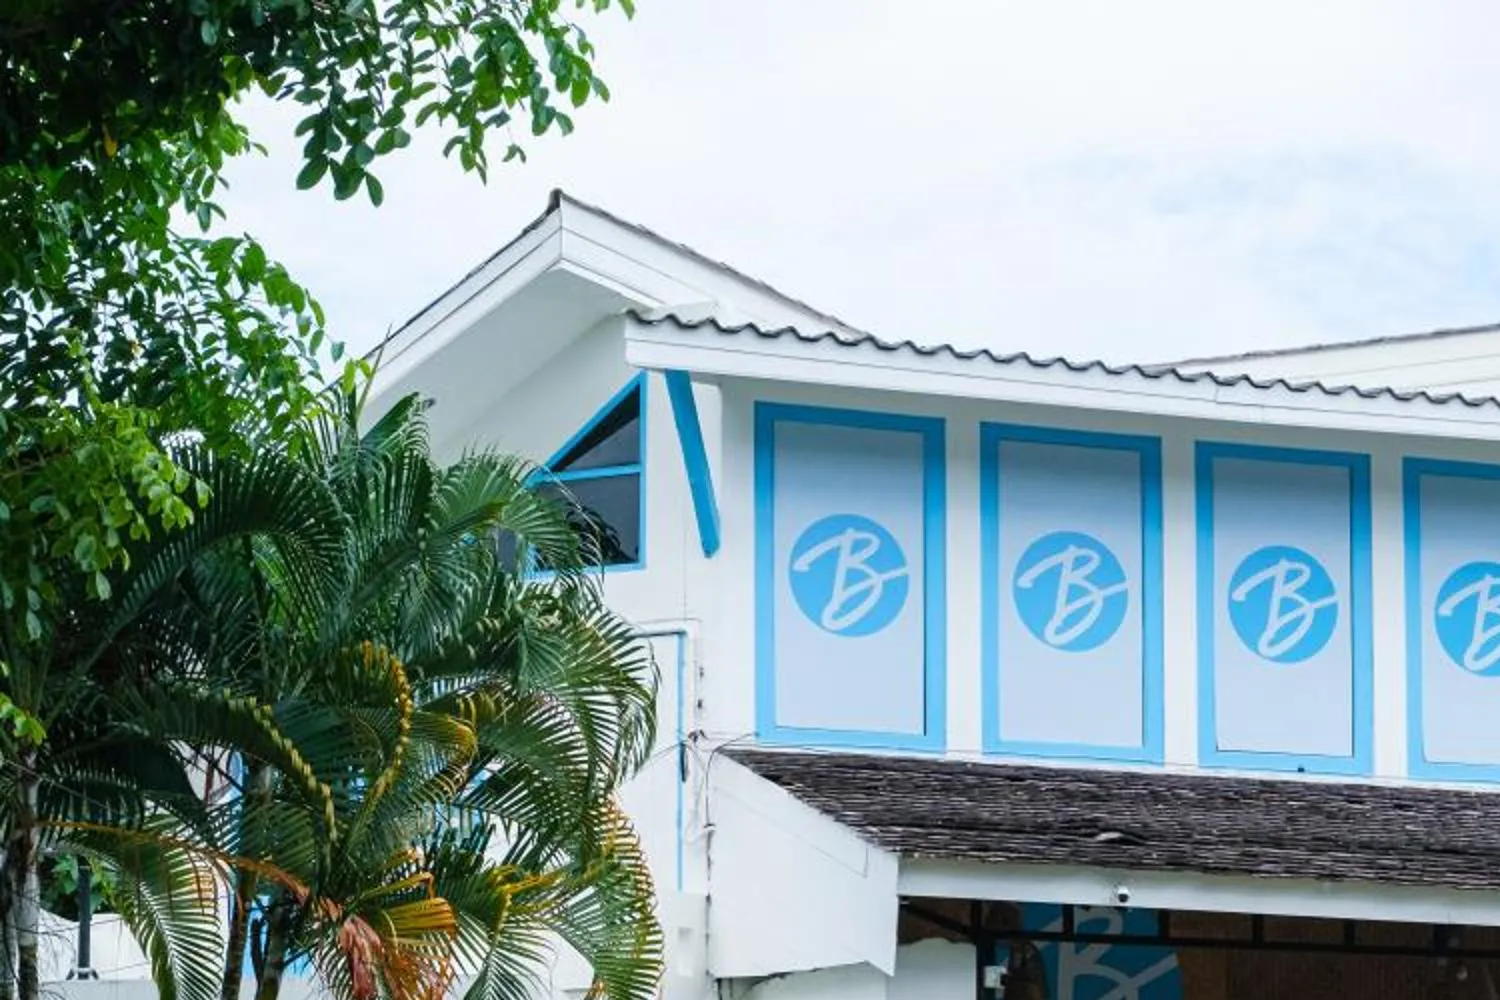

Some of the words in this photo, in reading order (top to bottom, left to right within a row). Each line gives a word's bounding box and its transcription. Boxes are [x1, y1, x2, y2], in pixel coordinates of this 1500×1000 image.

[792, 528, 910, 633] B
[1017, 544, 1130, 647] B
[1231, 559, 1340, 660] B
